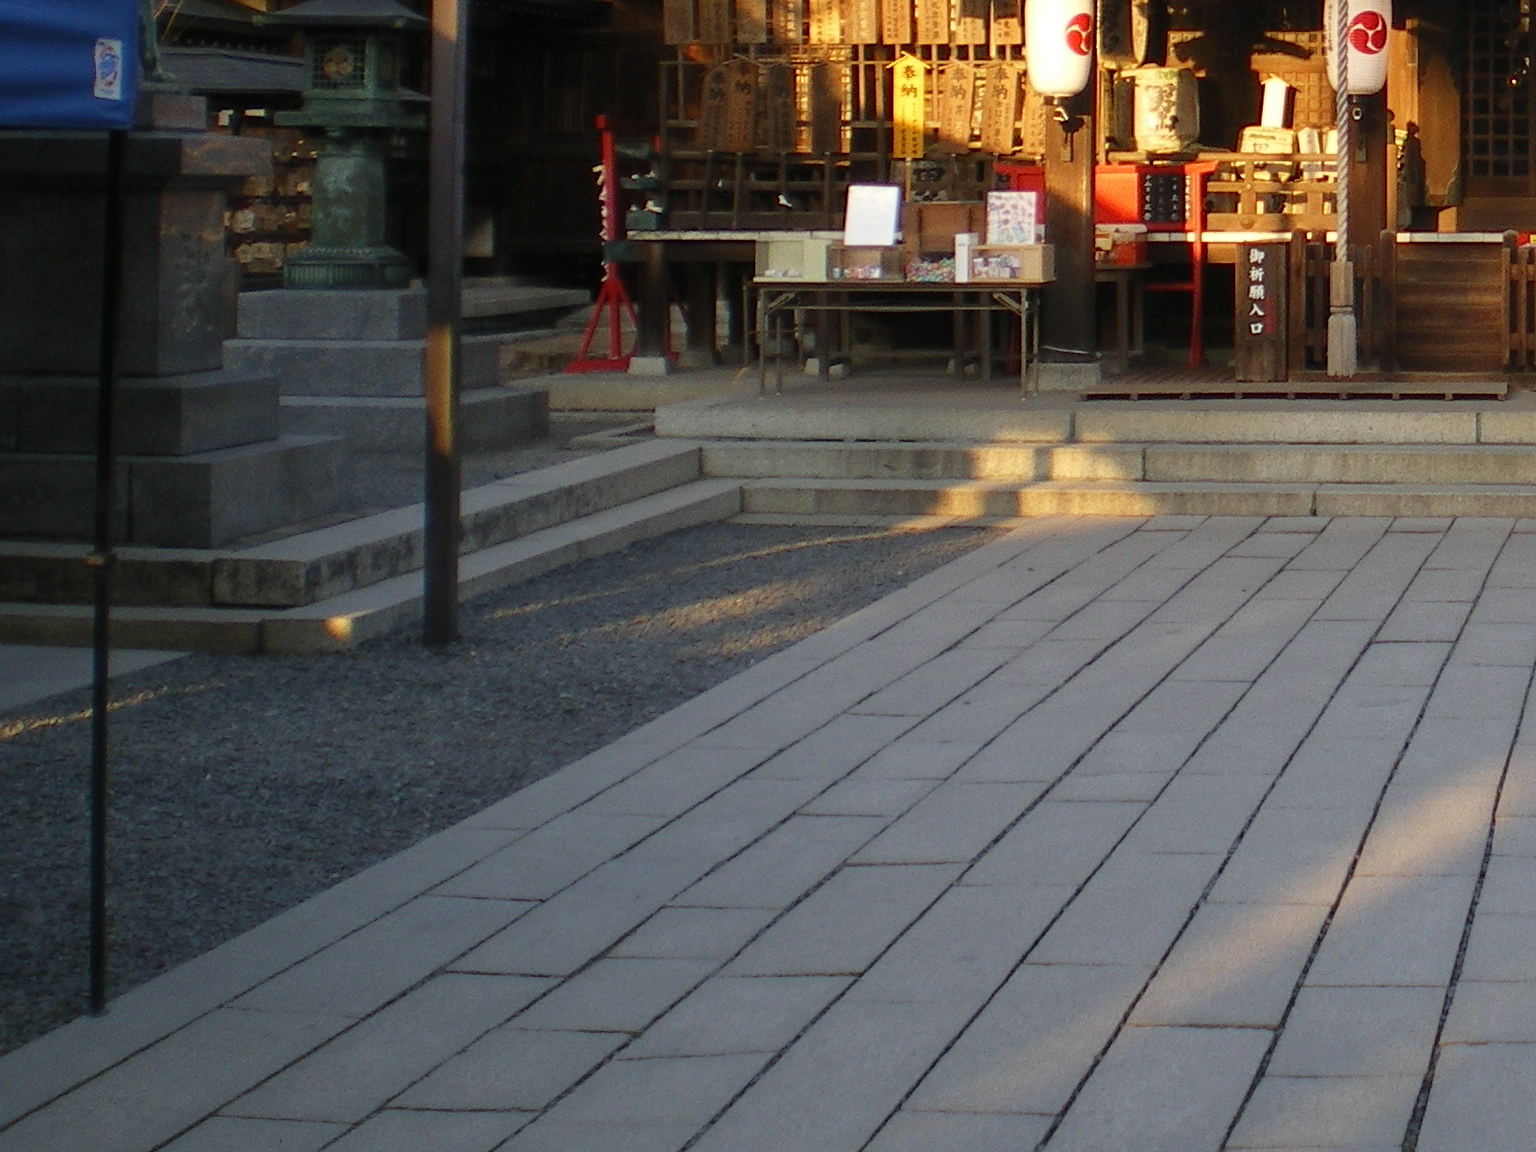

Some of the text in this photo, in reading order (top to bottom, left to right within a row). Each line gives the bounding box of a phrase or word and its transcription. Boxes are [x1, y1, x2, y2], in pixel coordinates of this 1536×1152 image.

[901, 65, 918, 99] 奉納
[951, 66, 967, 100] 奉納
[991, 66, 1009, 100] 奉納
[1248, 248, 1265, 334] 御祈願入口
